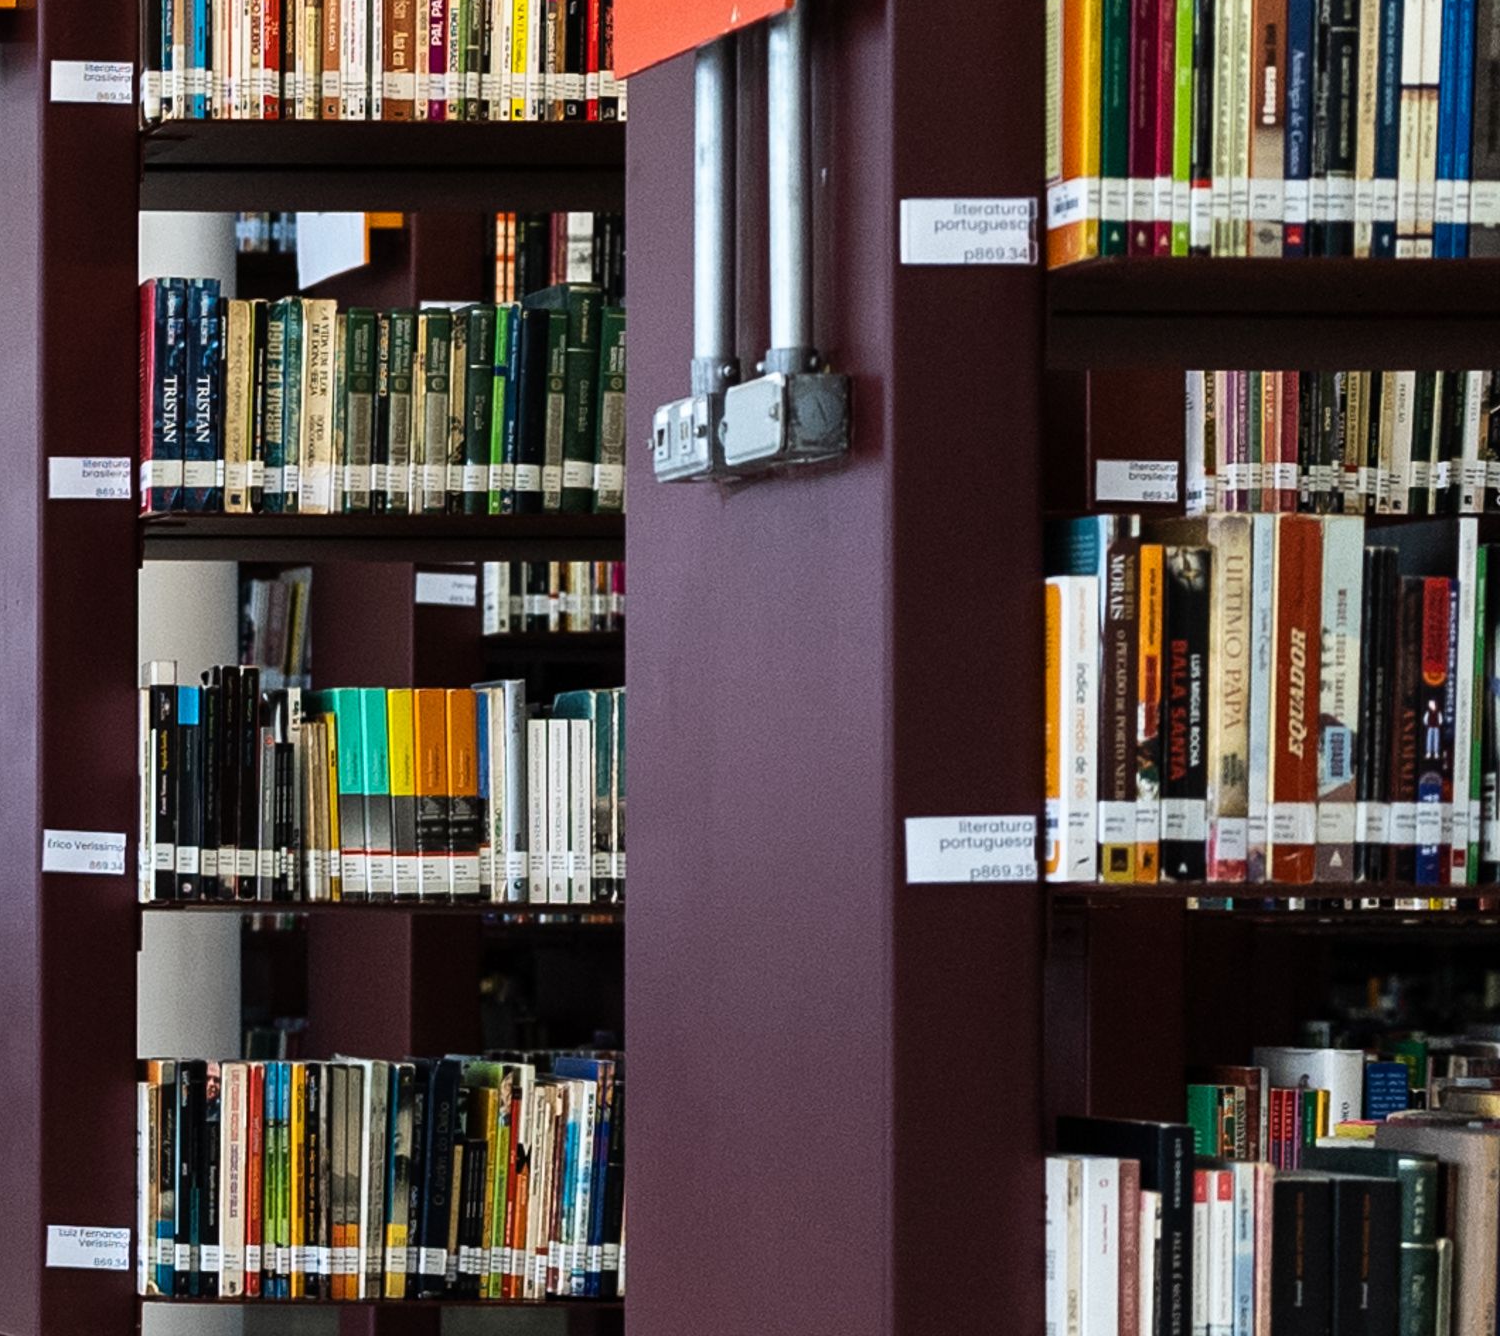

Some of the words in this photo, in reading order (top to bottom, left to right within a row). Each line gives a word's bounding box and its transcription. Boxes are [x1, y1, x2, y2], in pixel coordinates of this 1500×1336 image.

[392, 30, 409, 49] Ana
[432, 20, 443, 46] PAI,
[1289, 48, 1306, 109] Antologia
[1290, 112, 1305, 127] de
[1289, 129, 1304, 175] Contos
[953, 204, 1029, 216] literatura
[266, 320, 284, 360] FOGO
[310, 323, 320, 337] DE
[319, 323, 329, 346] VIDA
[266, 364, 284, 383] DE
[310, 339, 320, 368] DONA
[319, 350, 329, 366] EM
[319, 370, 329, 396] FLOR
[162, 375, 178, 443] TRISTAN
[195, 375, 211, 443] TRISTAN
[266, 388, 284, 444] ARRAIA
[1109, 553, 1127, 621] MORAIS
[1336, 588, 1349, 629] MIGUEL
[1075, 662, 1090, 704] índice
[1114, 641, 1130, 695] PECADO
[1172, 639, 1190, 700] BALA
[1190, 680, 1203, 722] MIGUEL
[1223, 667, 1243, 730] PAPA
[1287, 625, 1308, 761] EQUADOR
[1113, 715, 1128, 759] PORTO
[1171, 706, 1189, 780] SANTA
[1188, 724, 1202, 767] ROCHA
[1329, 731, 1345, 778] EQUADOR
[1076, 756, 1090, 774] de
[1112, 763, 1127, 800] NEGR
[940, 836, 1033, 853] portuguesa
[959, 821, 1033, 833] literatura
[970, 865, 1034, 881] p869.35
